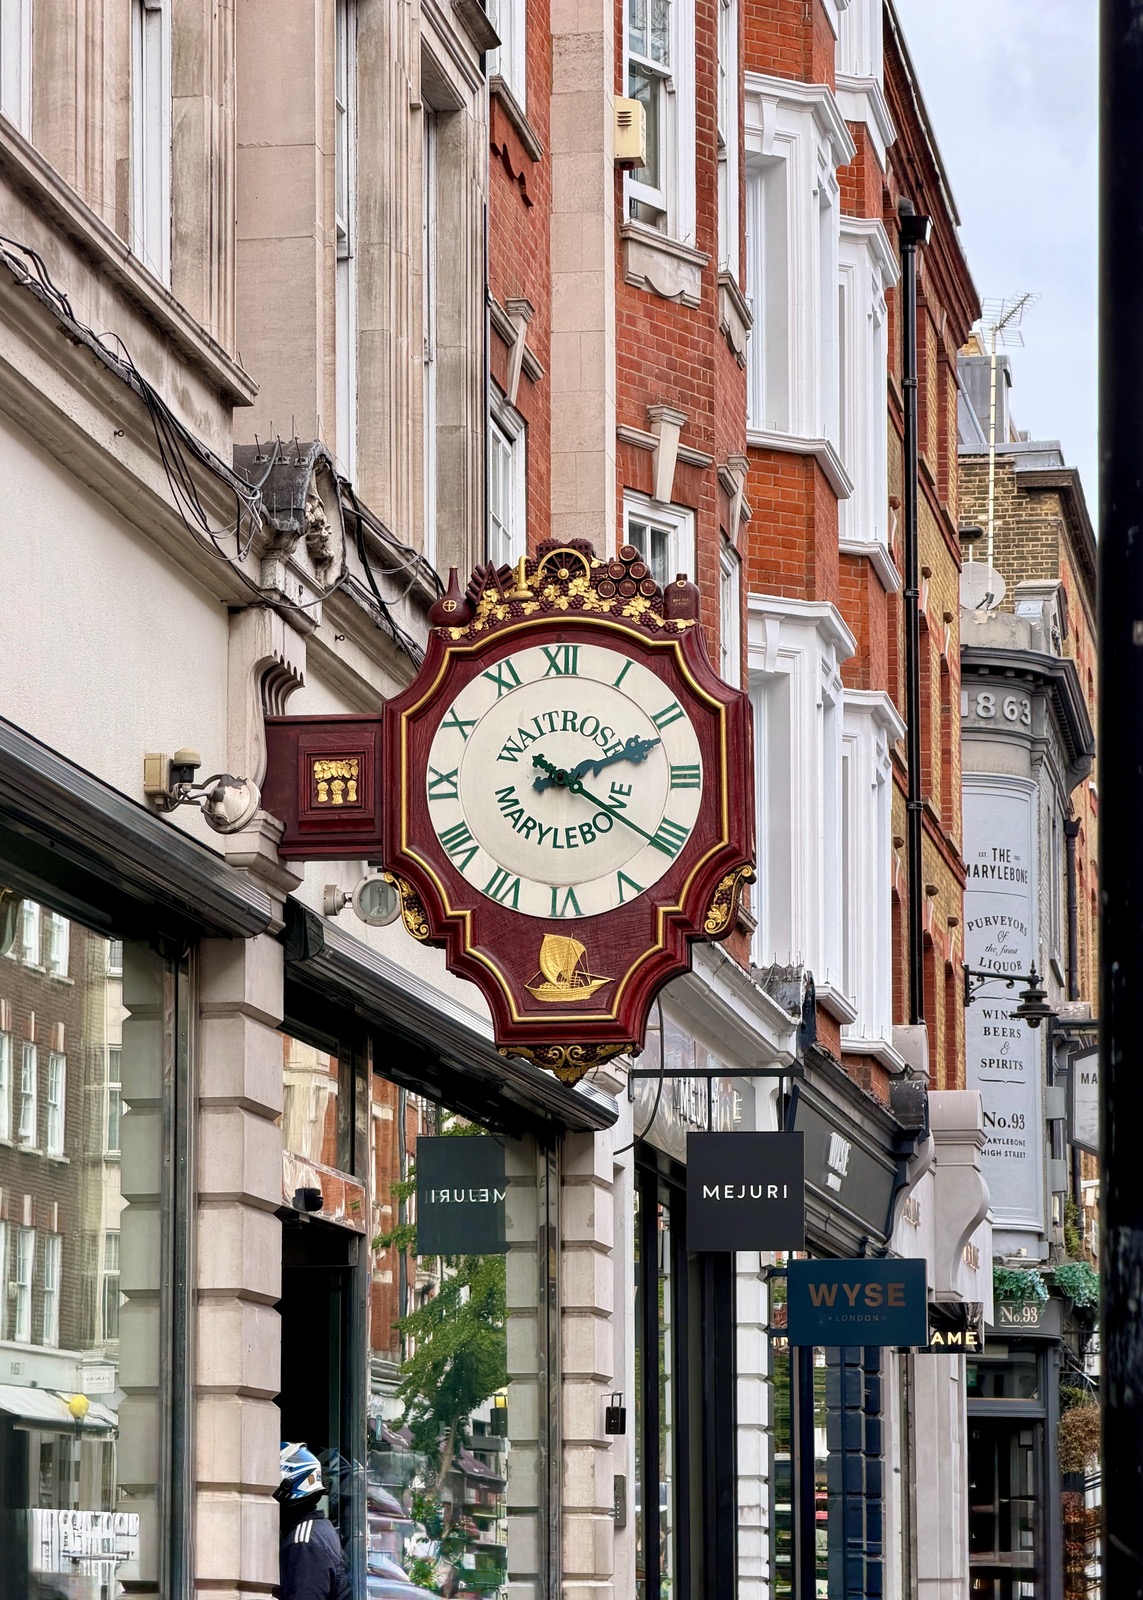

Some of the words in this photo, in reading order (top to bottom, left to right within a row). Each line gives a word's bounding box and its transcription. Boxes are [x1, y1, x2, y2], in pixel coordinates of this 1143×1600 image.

[539, 645, 582, 678] XII
[611, 659, 635, 689] I
[480, 657, 524, 700] XI
[650, 701, 686, 733] II
[961, 691, 1031, 725] 1863
[439, 704, 480, 743] X
[496, 710, 625, 762] WAITROSE
[428, 764, 459, 801] IX
[670, 763, 700, 791] III
[495, 781, 632, 849] MARYLEBONE
[437, 819, 480, 874] VIII
[992, 848, 1011, 863] THE
[481, 865, 520, 910] VII
[617, 870, 646, 905] V
[548, 886, 585, 917] VI
[966, 915, 1027, 937] PURVEYORS
[984, 943, 997, 953] the
[979, 956, 1022, 973] LIQUOR
[982, 1009, 1021, 1022] WINE
[983, 1026, 1021, 1039] BEERS
[1000, 1041, 1011, 1055] &
[981, 1058, 1023, 1071] SPIRITS
[983, 1111, 1025, 1130] No.93
[980, 1149, 1002, 1157] HIGH
[1004, 1150, 1026, 1158] STREET
[986, 1137, 1026, 1147] ARYLEBONE
[703, 1184, 788, 1200] MEJURI
[808, 1283, 906, 1307] WYSE
[1000, 1306, 1038, 1323] No.93
